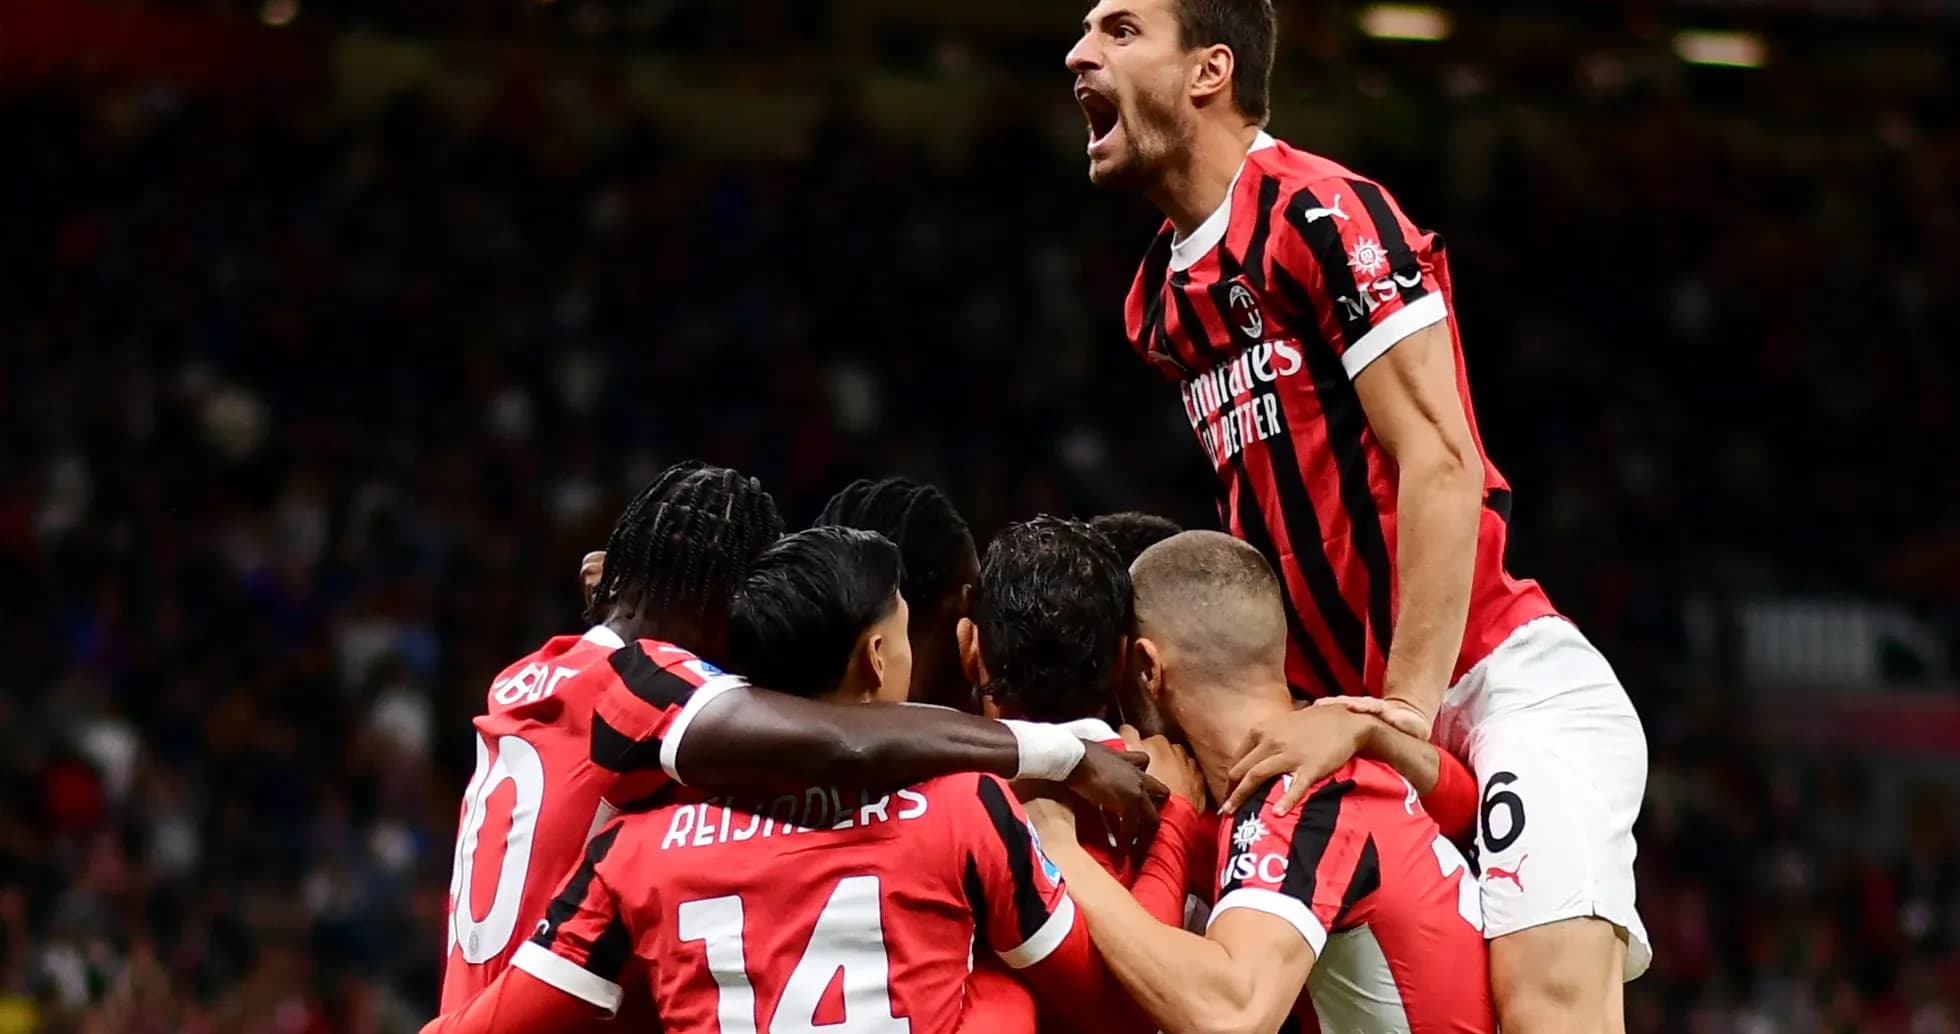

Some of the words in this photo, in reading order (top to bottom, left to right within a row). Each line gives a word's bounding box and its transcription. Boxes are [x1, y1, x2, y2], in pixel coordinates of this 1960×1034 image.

[1220, 393, 1281, 459] BETTER
[660, 783, 928, 850] REIJNDERS
[678, 874, 911, 1034] 14
